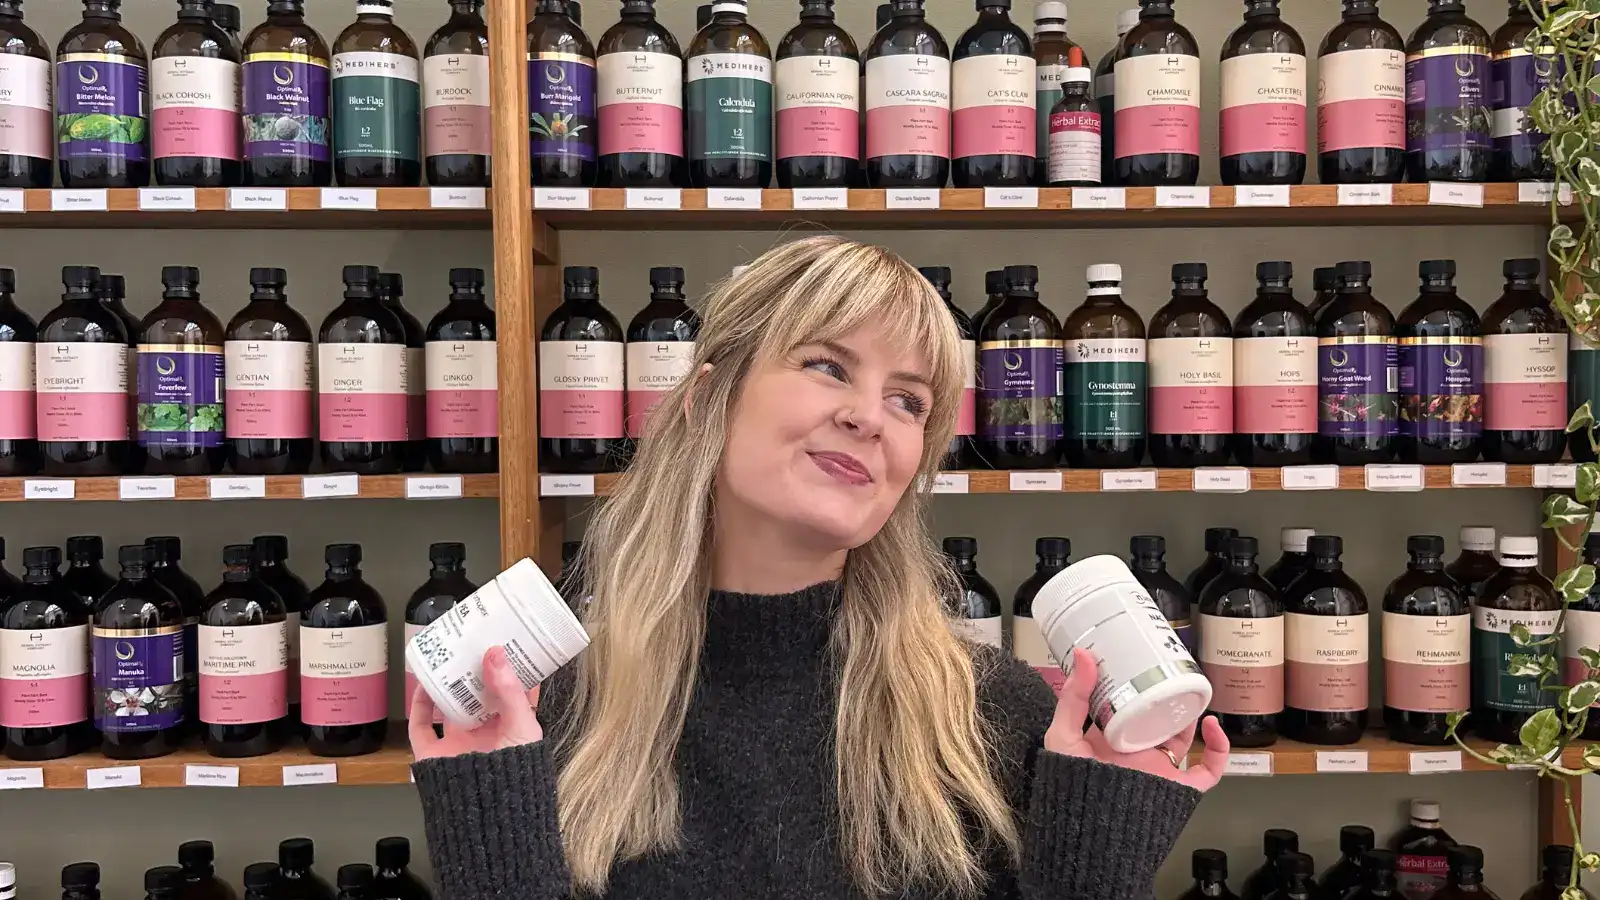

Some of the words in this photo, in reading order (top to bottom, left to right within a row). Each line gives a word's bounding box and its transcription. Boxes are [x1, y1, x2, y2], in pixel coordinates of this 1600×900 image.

[345, 61, 397, 69] MEDIHERB
[716, 62, 764, 72] MEDIHERB
[1147, 89, 1192, 97] CHAMOMILE
[1257, 88, 1303, 96] CHASTETREE
[1460, 85, 1480, 93] Clivers
[156, 92, 174, 100] BLACK
[175, 92, 211, 100] COHOSH
[555, 93, 582, 102] Marigold
[786, 91, 835, 100] CALIFORNIAN
[885, 89, 921, 98] CASCARA
[987, 90, 1010, 98] CAT'S
[1010, 90, 1029, 98] CLAW
[285, 94, 310, 102] Walnut
[349, 96, 366, 105] Blue
[367, 96, 384, 107] Flag
[718, 97, 756, 107] Calendula
[1051, 116, 1076, 128] Herbal
[361, 126, 371, 135] 1:2
[733, 128, 743, 136] 1:2
[44, 377, 85, 385] EYEBRIGHT
[333, 378, 363, 386] GINGER
[1354, 374, 1372, 382] Weed
[1004, 379, 1035, 387] Gymnema
[1088, 381, 1136, 391] Gynostemma
[459, 603, 470, 618] PEA
[1216, 648, 1272, 658] POMEGRANATE
[1316, 649, 1359, 657] RASPBERRY
[13, 663, 56, 672] MAGNOLIA
[203, 660, 236, 668] MARITIME
[238, 660, 256, 668] PINE
[308, 661, 367, 670] MARSHMALLOW
[118, 668, 144, 676] Manuka
